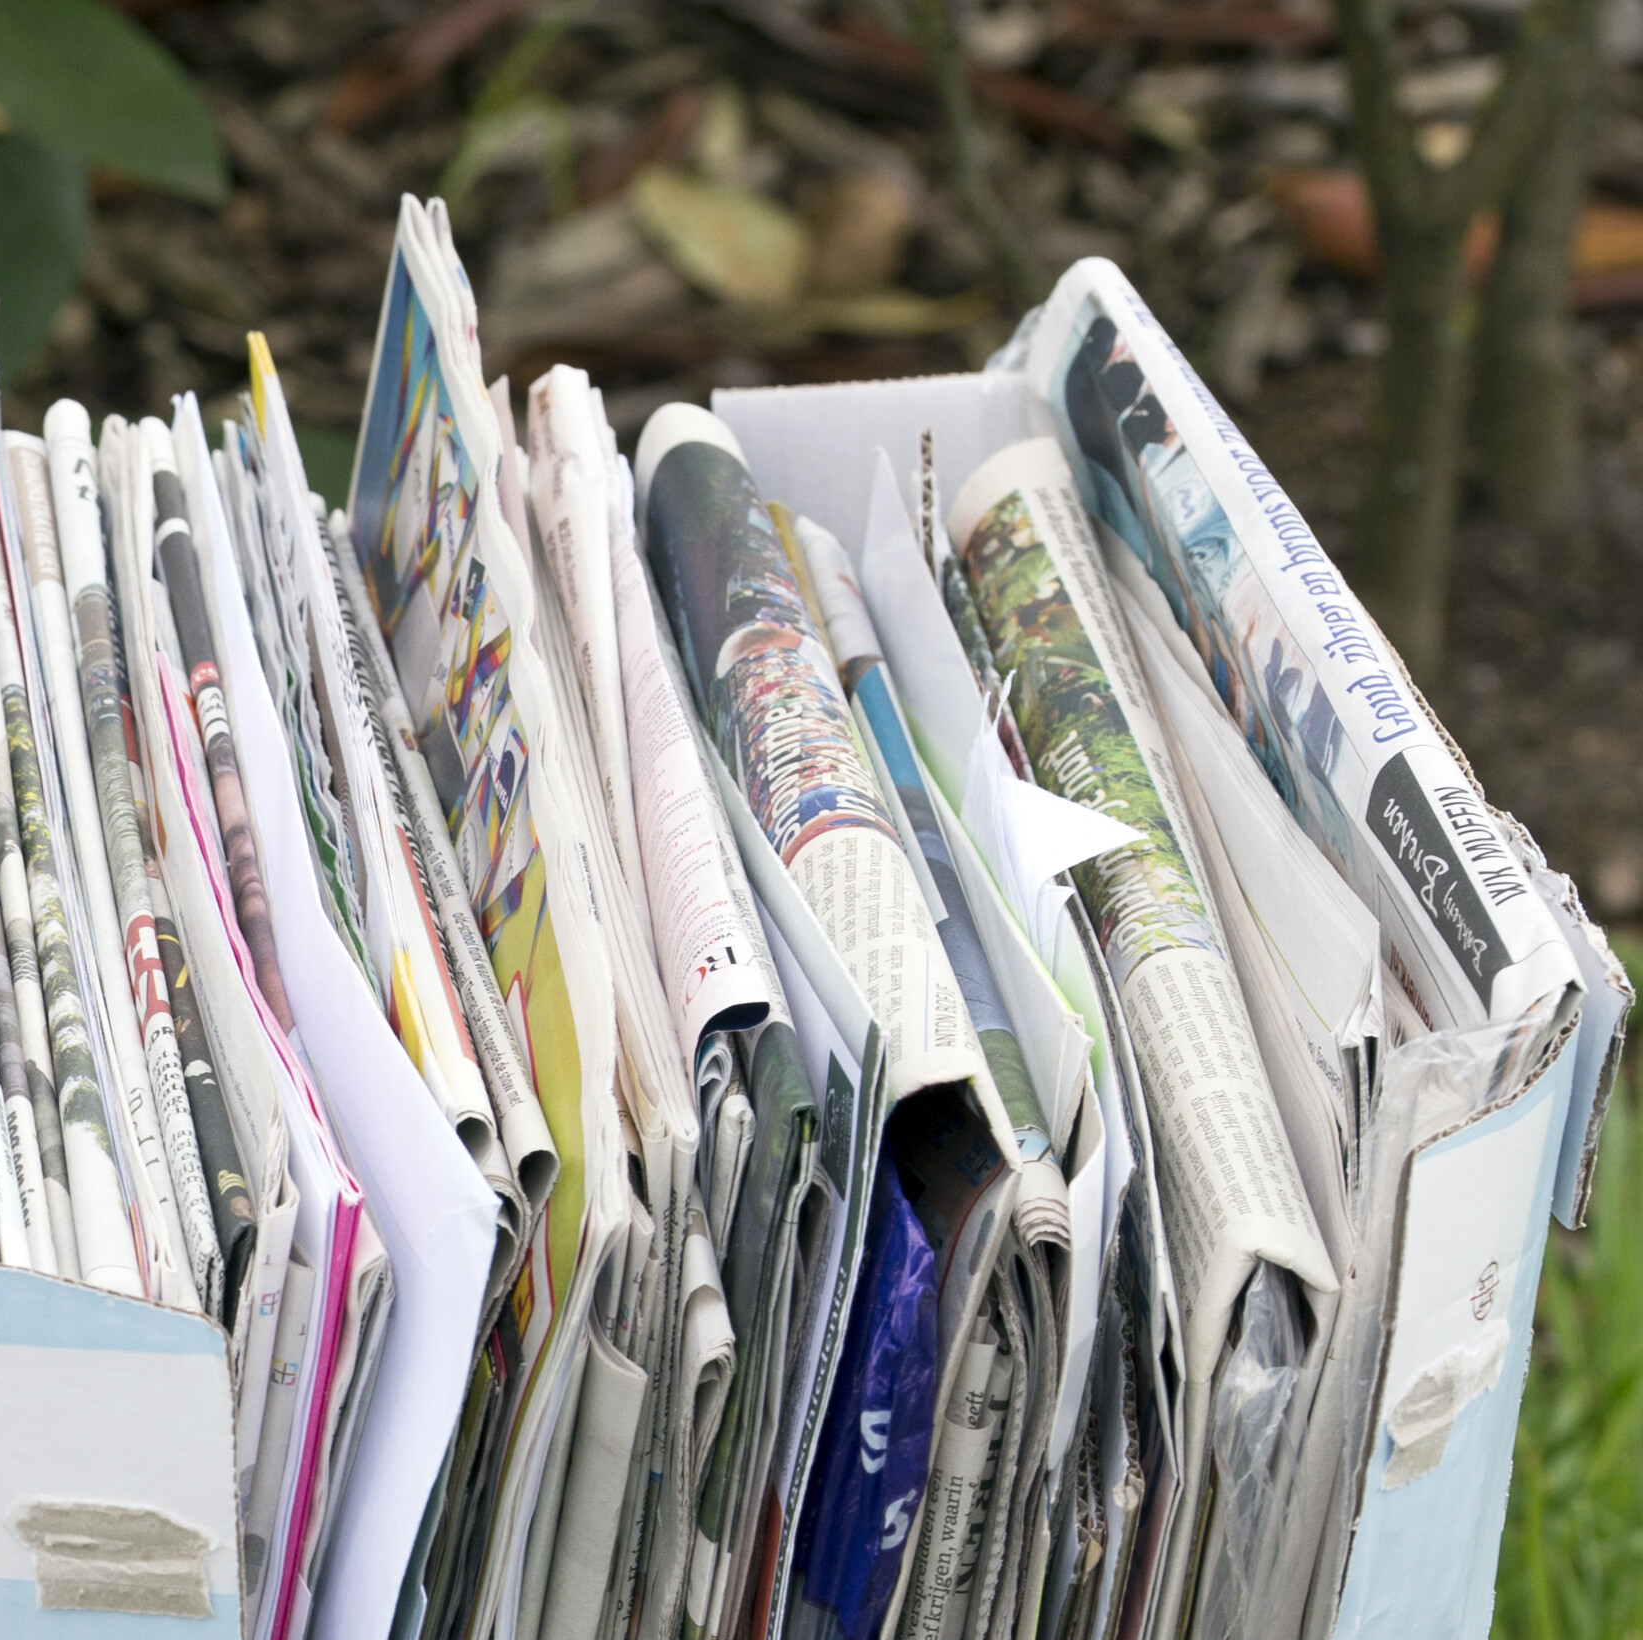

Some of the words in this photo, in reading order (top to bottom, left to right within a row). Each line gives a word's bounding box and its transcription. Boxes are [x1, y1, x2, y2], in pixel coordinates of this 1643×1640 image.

[1225, 441, 1285, 509] voor
[1248, 496, 1322, 579] brons
[1296, 561, 1341, 608] en
[1304, 593, 1381, 682] zilver
[1343, 664, 1421, 750] Goud,
[1433, 778, 1506, 868] MUFFIN
[1478, 860, 1527, 906] WK
[1189, 1106, 1226, 1149] optreden
[903, 1506, 937, 1639] verspreidden
[925, 1545, 957, 1622] krijgen,
[941, 1474, 963, 1541] waarin
